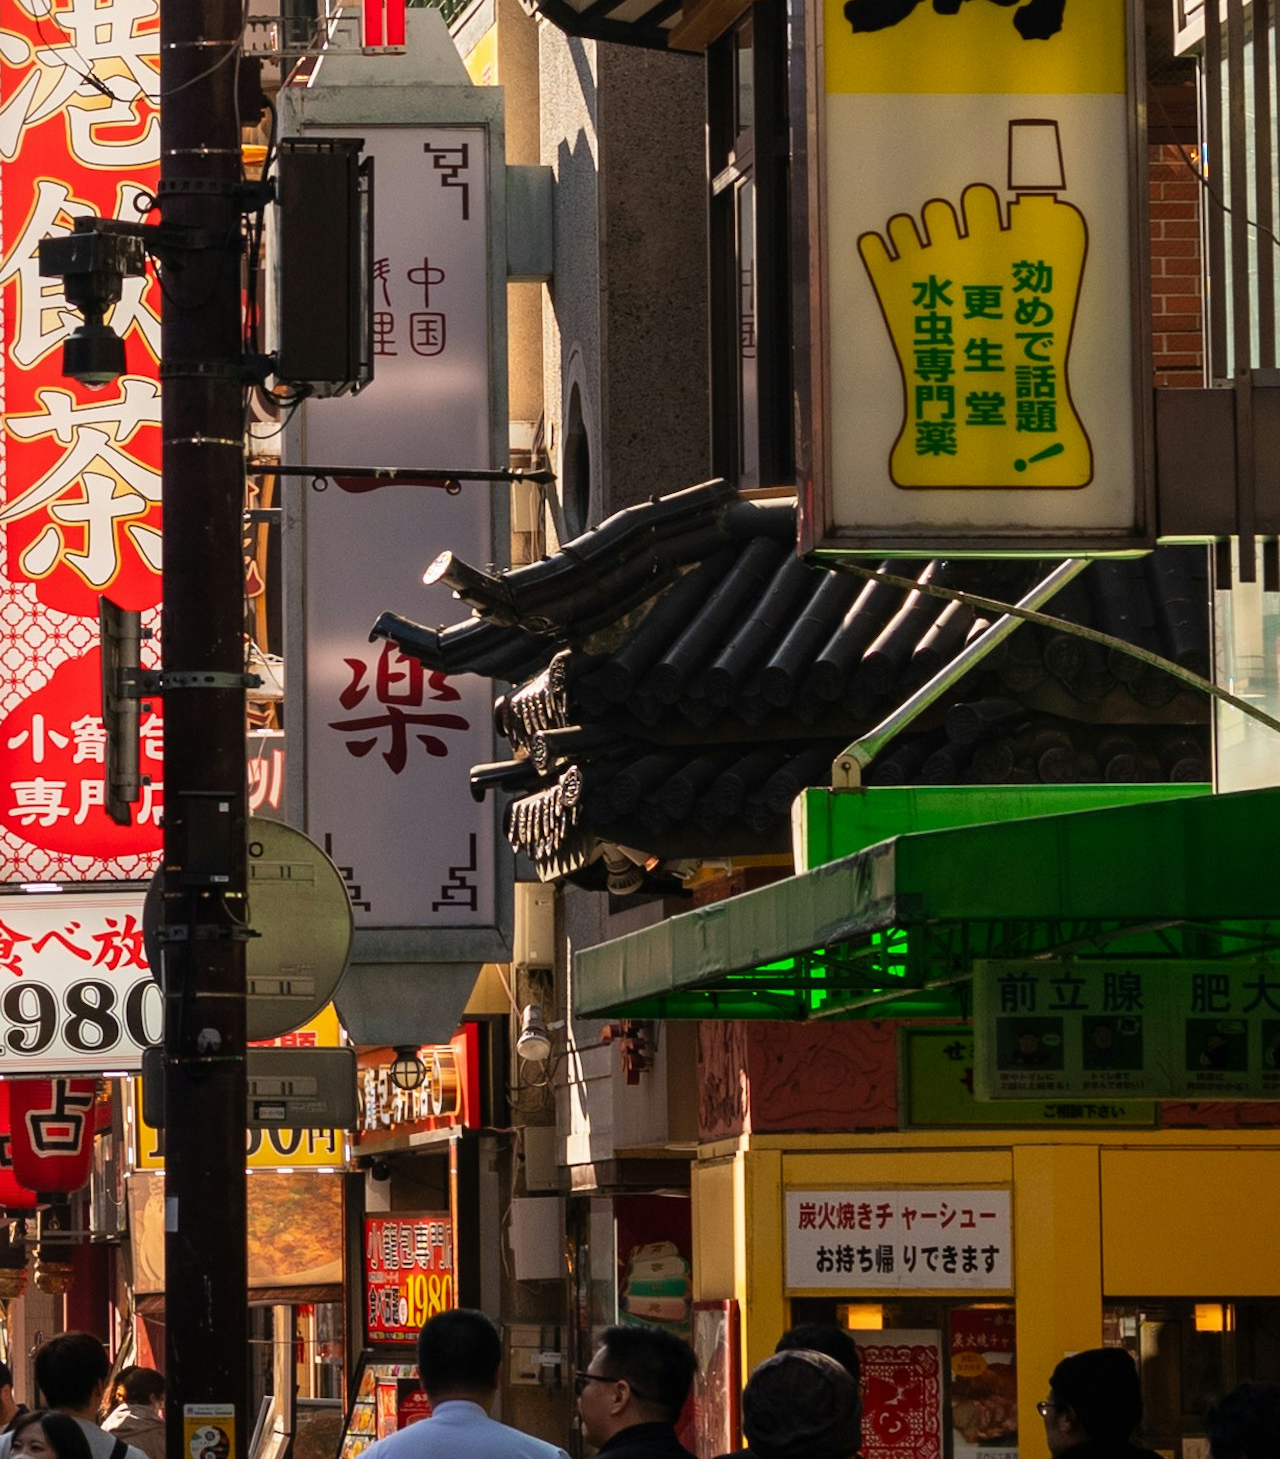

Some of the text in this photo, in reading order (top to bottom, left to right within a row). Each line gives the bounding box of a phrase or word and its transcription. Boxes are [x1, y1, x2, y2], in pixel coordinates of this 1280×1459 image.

[912, 275, 958, 456] 水虫専門薬
[962, 285, 1006, 426] 更生堂
[996, 970, 1144, 1013] 前立腺
[798, 1201, 997, 1231] 炭火焼きチャーシュー
[816, 1243, 1000, 1274] お持ち帰りできます
[952, 1332, 1014, 1349] 炭火焼チャ
